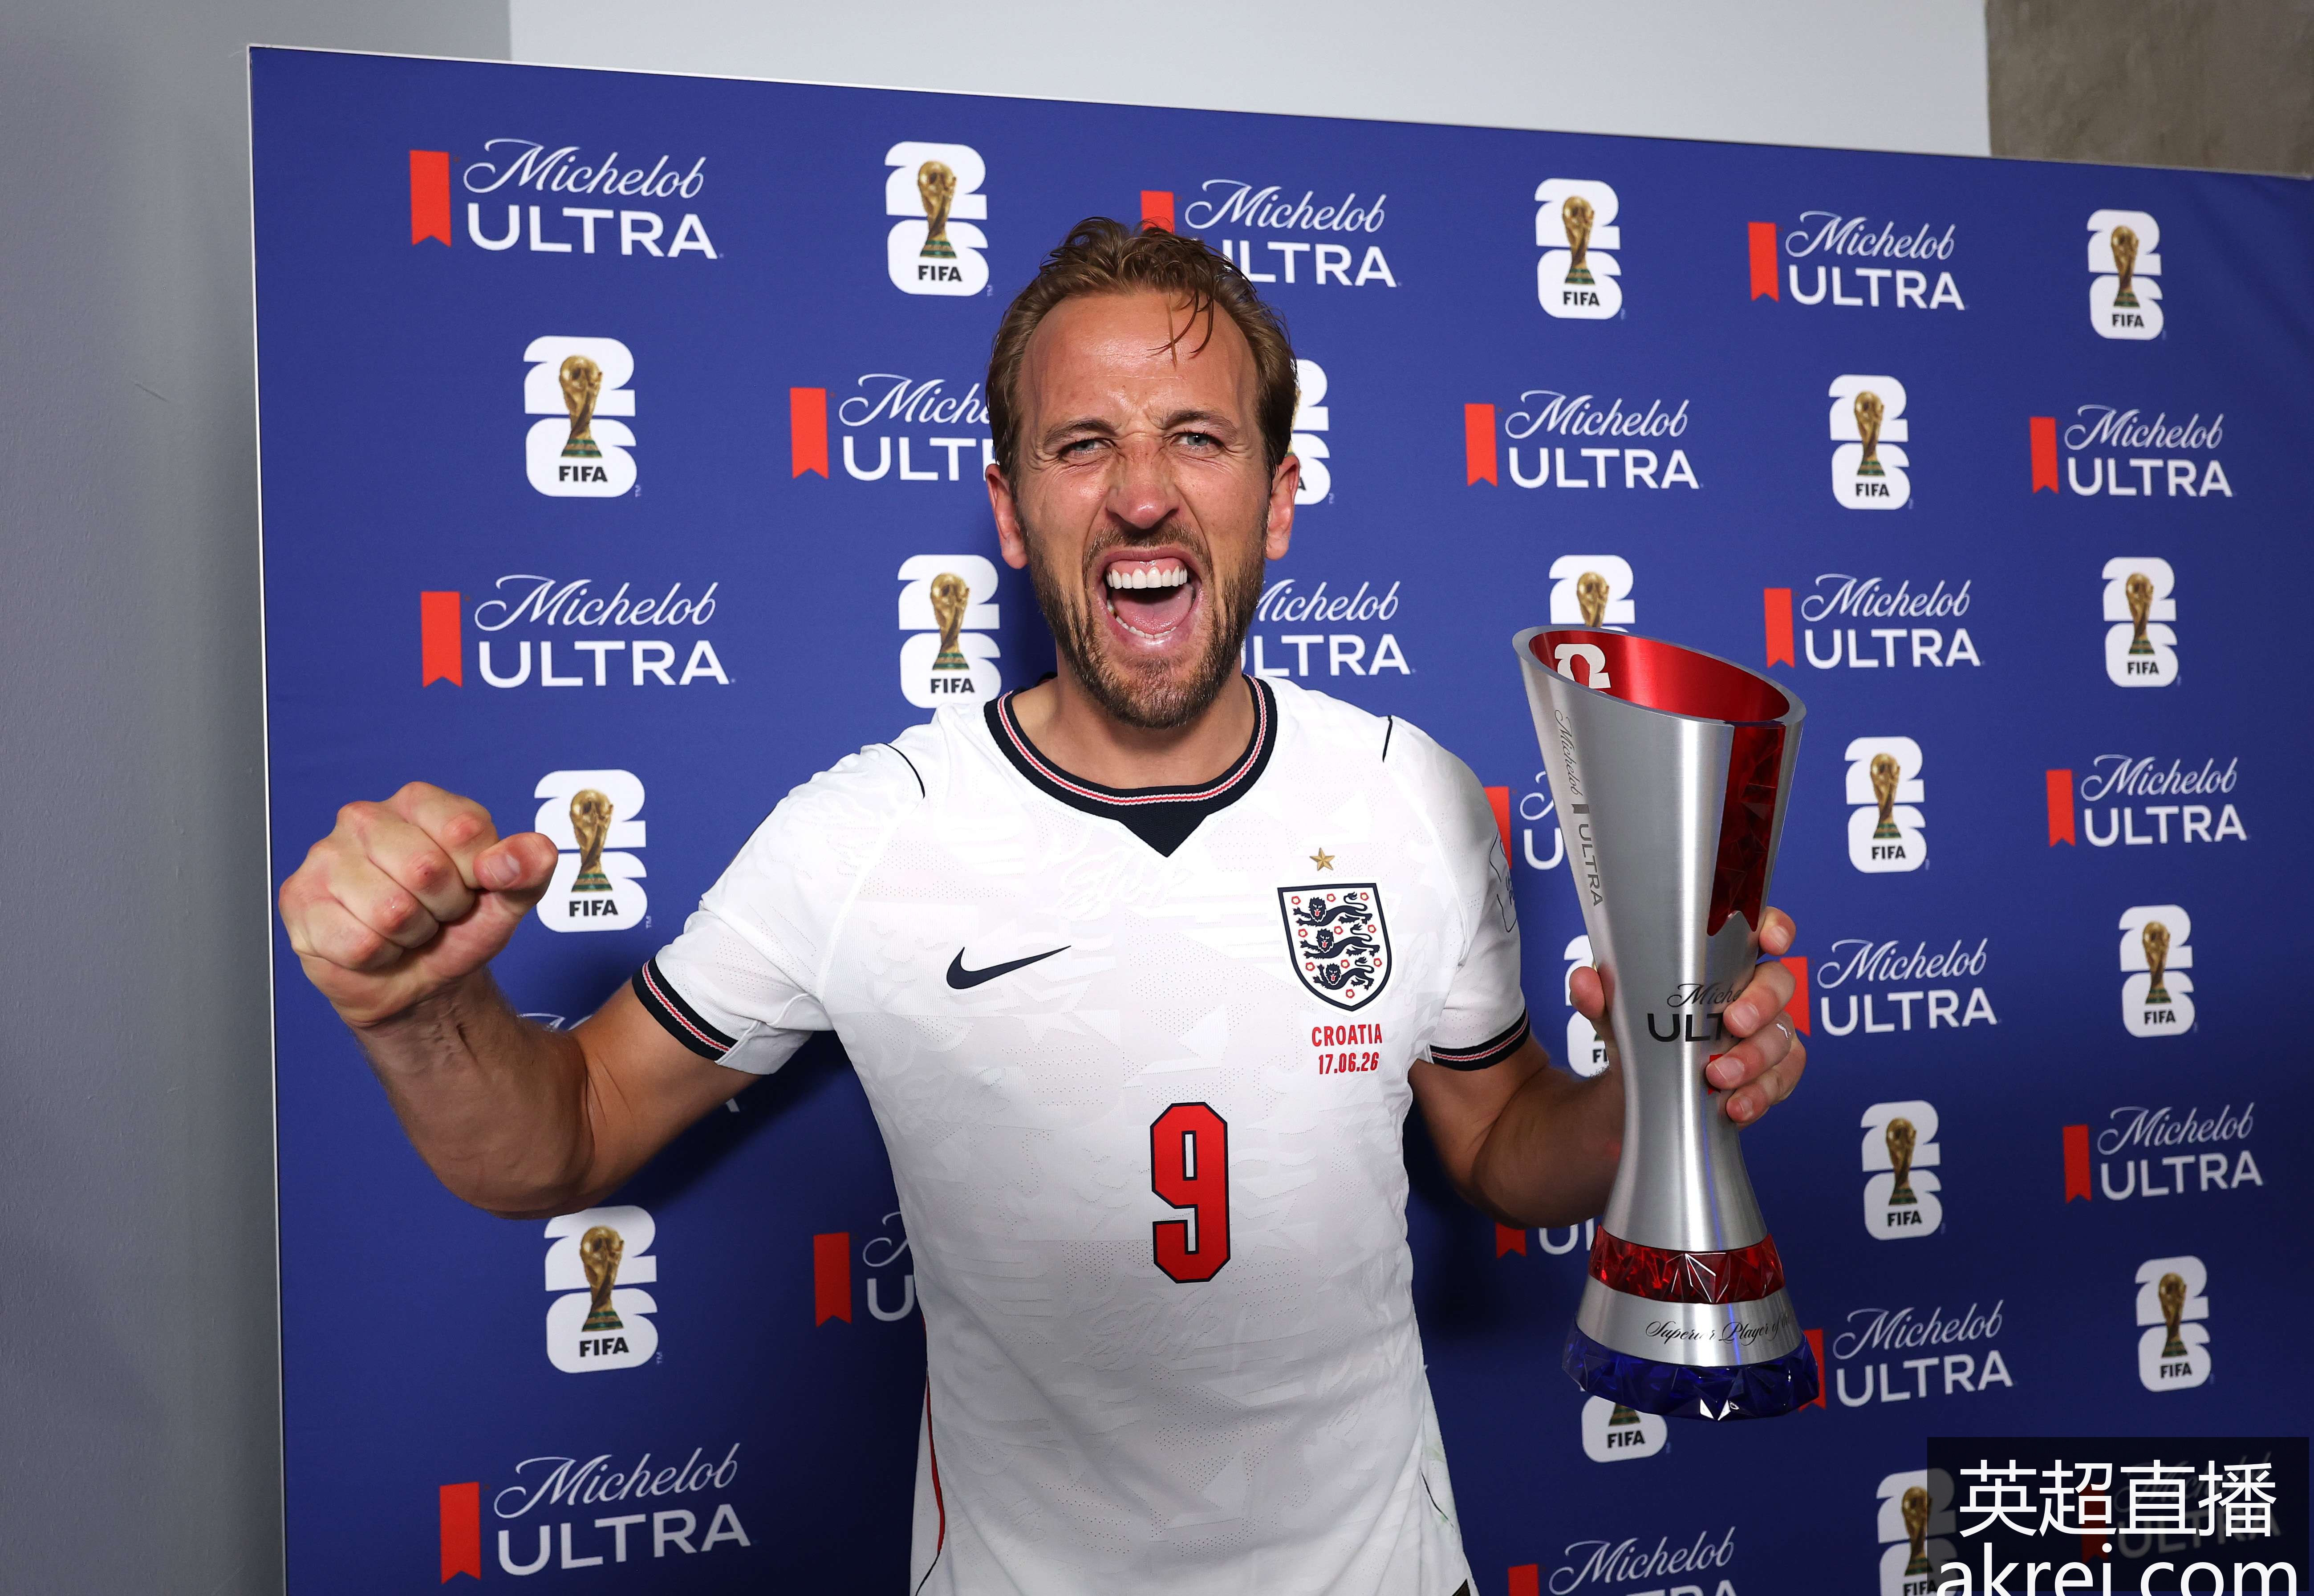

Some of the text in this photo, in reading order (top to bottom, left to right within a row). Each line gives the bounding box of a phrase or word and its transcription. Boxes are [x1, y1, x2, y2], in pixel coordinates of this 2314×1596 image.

[463, 138, 706, 199] Michelob
[1185, 179, 1387, 232] Michelob
[467, 203, 718, 260] ULTRA
[1785, 211, 1956, 260] Michelob
[918, 265, 962, 282] FIFA
[1789, 265, 1965, 310] ULTRA
[1563, 291, 1600, 306] FIFA
[2112, 314, 2144, 327] FIFA
[1505, 390, 1689, 439] Michelob
[2064, 405, 2224, 450] Michelob
[559, 466, 608, 482] FIFA
[843, 435, 996, 481] ULT
[1508, 447, 1700, 489] ULTRA
[2067, 457, 2233, 497] ULTRA
[1855, 483, 1890, 497] FIFA
[475, 574, 719, 631] Michelob
[1801, 573, 1971, 622] Michelob
[479, 640, 730, 688] ULTRA
[1241, 633, 1411, 677] LTRA
[1805, 628, 1981, 670] ULTRA
[2127, 662, 2159, 674] FIFA
[930, 678, 975, 694] FIFA
[1555, 709, 1583, 796] Michelob
[2081, 754, 2238, 801] Michelob
[2084, 804, 2247, 847] ULTRA
[1579, 824, 1603, 906] ULTRA
[1871, 845, 1906, 860] FIFA
[569, 899, 618, 917] FIFA
[1817, 938, 1988, 989] Michelob
[1667, 982, 1742, 1007] Miche
[1821, 987, 1997, 1036] ULTRA
[1312, 1023, 1382, 1047] CROATIA
[1647, 1012, 1723, 1042] ULT
[2144, 1010, 2176, 1024] FIFA
[1319, 1052, 1379, 1075] 17.06.26
[2097, 1102, 2254, 1155] Michelob
[1150, 1101, 1231, 1284] 9
[2100, 1150, 2263, 1201] ULTRA
[1887, 1210, 1922, 1227] FIFA
[580, 1337, 629, 1357] FIFA
[1718, 1321, 1768, 1346] Player
[1833, 1300, 2003, 1360] Michelob
[1836, 1350, 2014, 1407] ULTRA
[2160, 1362, 2192, 1378] FIFA
[1607, 1430, 1646, 1449] FIFA
[494, 1442, 740, 1519] Michelob
[498, 1504, 751, 1576] ULTRA
[1549, 1526, 1736, 1596] Michelob
